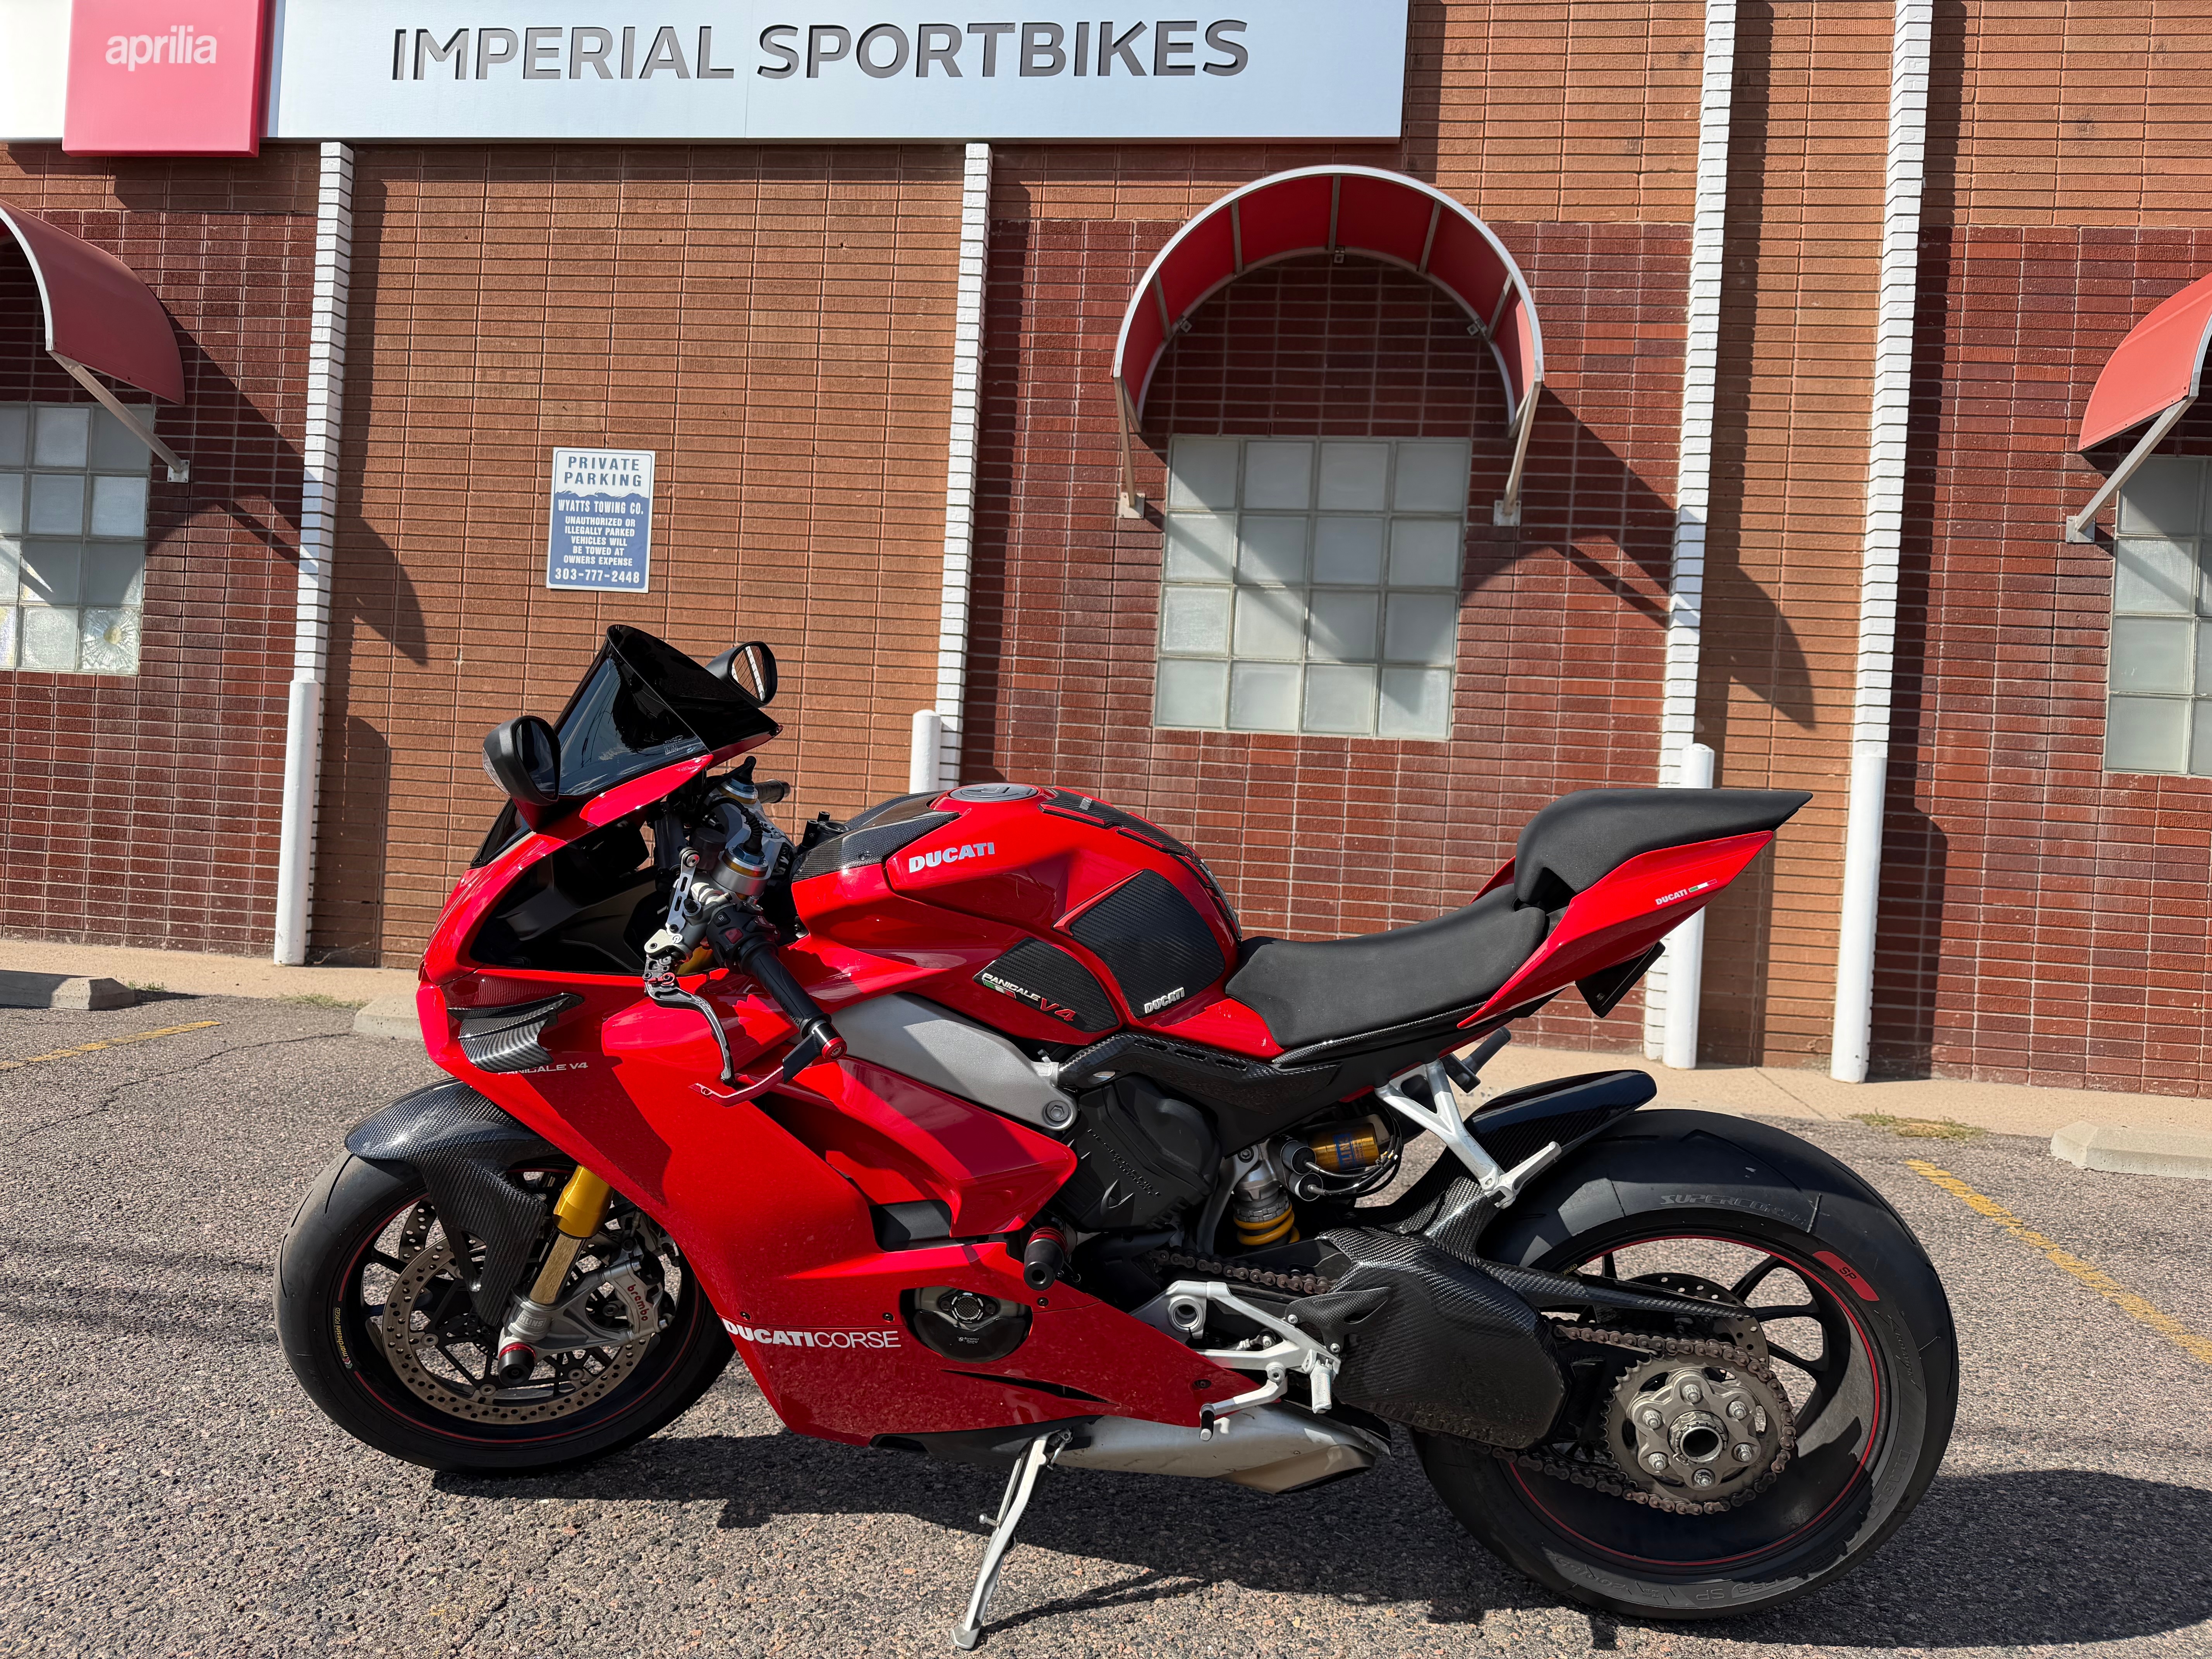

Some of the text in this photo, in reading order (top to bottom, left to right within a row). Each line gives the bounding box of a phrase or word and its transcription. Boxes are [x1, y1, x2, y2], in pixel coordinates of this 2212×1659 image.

[105, 25, 217, 72] aprilia
[392, 19, 1249, 81] IMPERIAL SPORTBIKES
[568, 456, 639, 471] PRIVATE
[564, 472, 642, 487] PARKING
[558, 499, 644, 515] WYATTS TOWING CO.
[565, 516, 635, 527] UNAUTHORIZED OR
[565, 526, 635, 537] ILLEGALLY PARKED
[571, 536, 627, 547] VEHICLES WILL
[573, 546, 624, 556] BE TOWED AT
[563, 555, 633, 567] OWNERS EXPENSE
[555, 567, 640, 584] 303-777-2448
[909, 842, 995, 873] DUCATI
[1655, 889, 1688, 905] DUCATI
[982, 973, 1076, 1022] PANIGALE V4
[1144, 987, 1185, 1014] DUCATI
[569, 1062, 588, 1072] V4
[1660, 1194, 1808, 1226] SUPERCORSA
[1839, 1266, 1857, 1280] SP
[627, 1284, 649, 1321] brembo
[519, 1314, 544, 1327] HLINS
[335, 1325, 349, 1357] marchesini
[1867, 1449, 1911, 1520] DIABLO
[1696, 1589, 1725, 1601] SP
